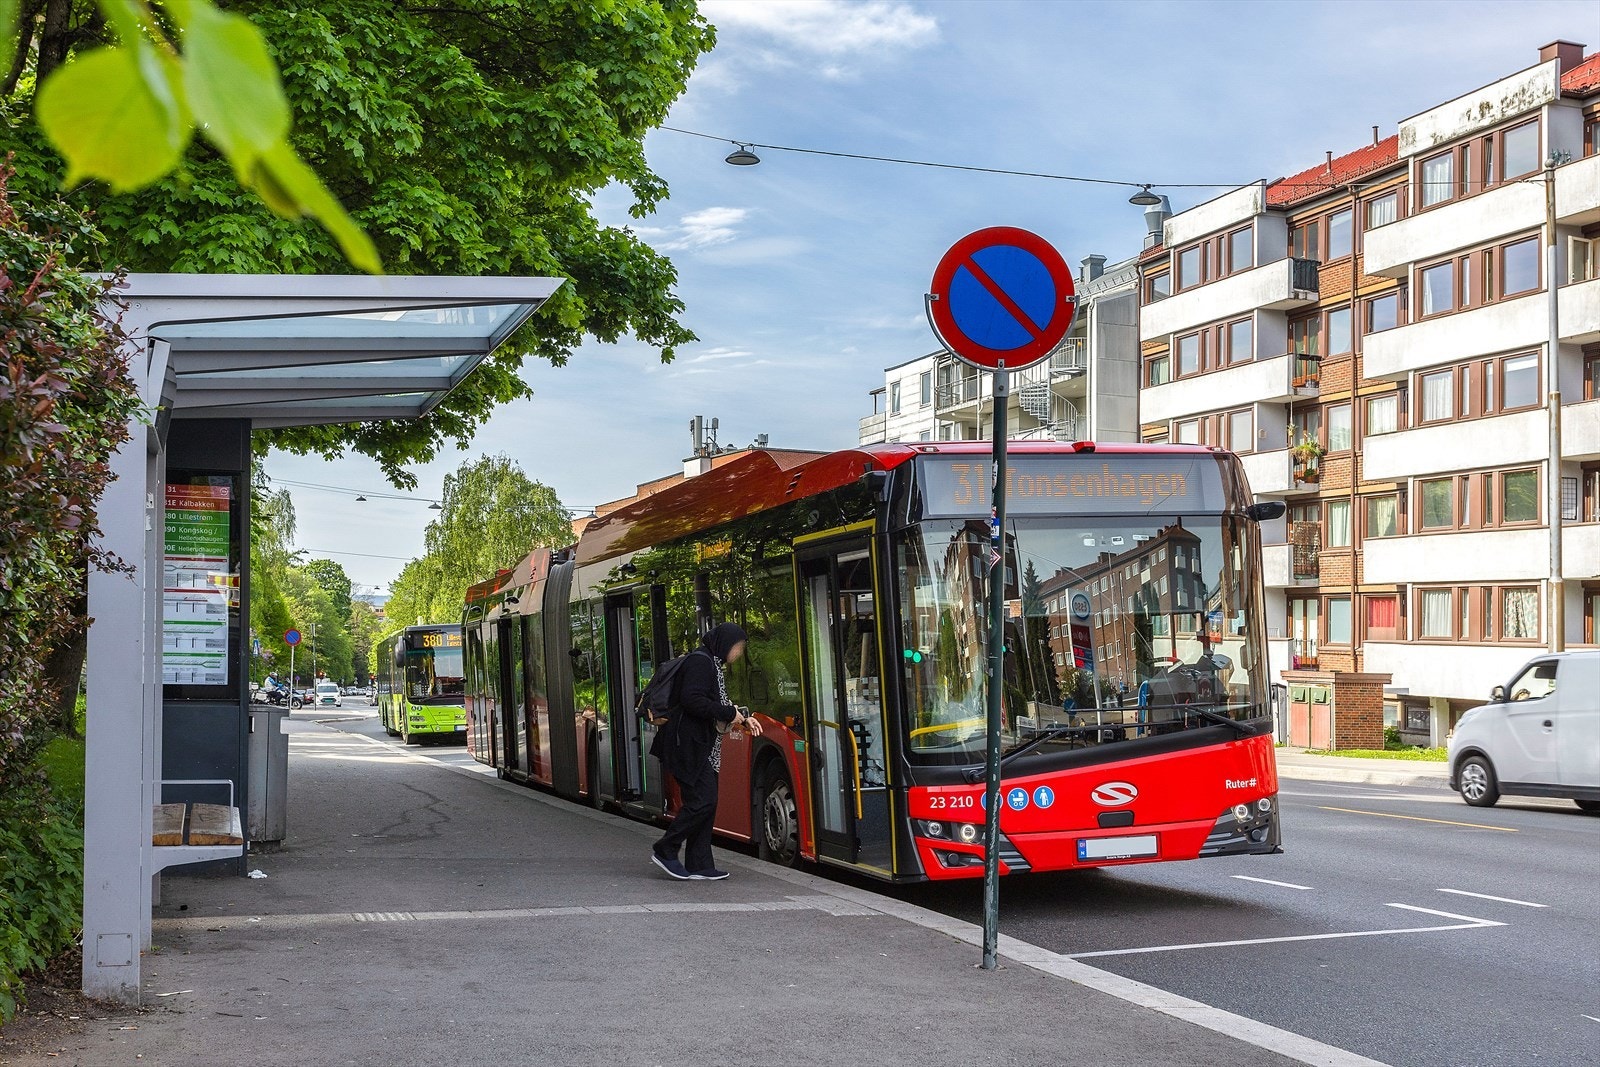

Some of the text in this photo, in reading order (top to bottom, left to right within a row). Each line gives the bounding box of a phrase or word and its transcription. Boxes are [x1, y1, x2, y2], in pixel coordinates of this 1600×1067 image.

[951, 464, 1187, 505] 31 Tonsenhagen
[179, 500, 215, 508] Kalbakken
[423, 634, 443, 647] 380
[1225, 778, 1257, 789] Ruter#
[930, 796, 974, 808] 23 210
